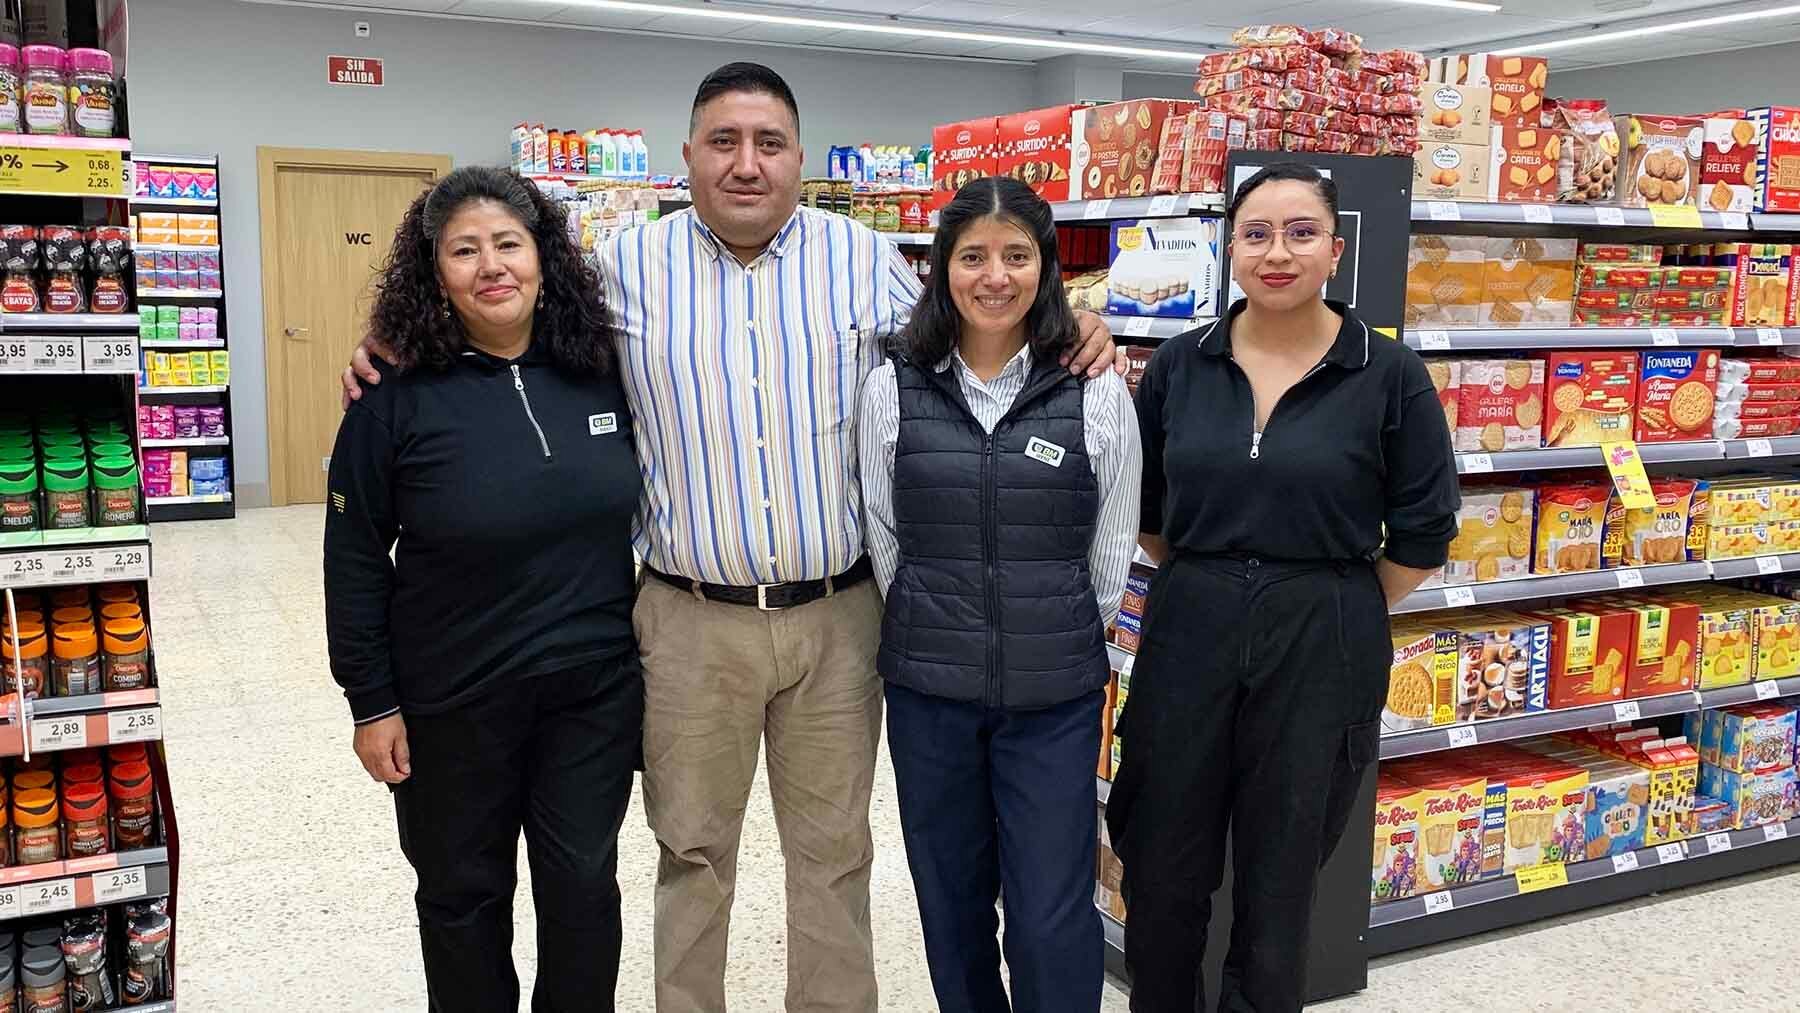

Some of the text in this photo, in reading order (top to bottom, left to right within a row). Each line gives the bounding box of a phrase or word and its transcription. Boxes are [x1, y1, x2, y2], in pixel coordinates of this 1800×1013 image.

[347, 59, 365, 71] SIN
[337, 70, 375, 83] SALIDA
[1494, 83, 1526, 93] CANELA
[1017, 137, 1047, 152] SURTIDO
[951, 148, 977, 160] SURTIDO
[1510, 156, 1541, 165] CANELA
[89, 160, 110, 171] 0,68
[1706, 163, 1741, 174] RELIEVE
[88, 178, 110, 188] 2,25
[345, 232, 371, 245] WC
[10, 295, 33, 306] BAYAS
[1735, 301, 1744, 321] PACK
[45, 345, 74, 358] 3,95
[103, 344, 132, 358] 3,95
[1647, 356, 1692, 370] FONTANEDA
[1653, 380, 1676, 391] Buena
[1646, 390, 1672, 402] María
[1478, 404, 1513, 417] MARÍA
[3, 516, 33, 526] ENELDO
[105, 511, 135, 521] ROMERO
[1655, 520, 1681, 533] ORO
[64, 556, 92, 569] 2,35
[114, 552, 142, 566] 2,29
[14, 559, 43, 573] 2,35
[1437, 634, 1457, 648] MÁS
[1402, 637, 1434, 660] Dorada
[1436, 661, 1457, 670] PRECIO
[6, 675, 34, 686] CANLA
[113, 673, 141, 683] COMINO
[128, 715, 154, 728] 2,35
[51, 723, 79, 736] 2,89
[1486, 792, 1505, 803] MÁS
[1511, 794, 1558, 812] Tosta Rica
[1425, 793, 1482, 816] Tosta Rica
[1388, 807, 1417, 826] Rica
[112, 872, 139, 887] 2,35
[41, 886, 68, 899] 2,45
